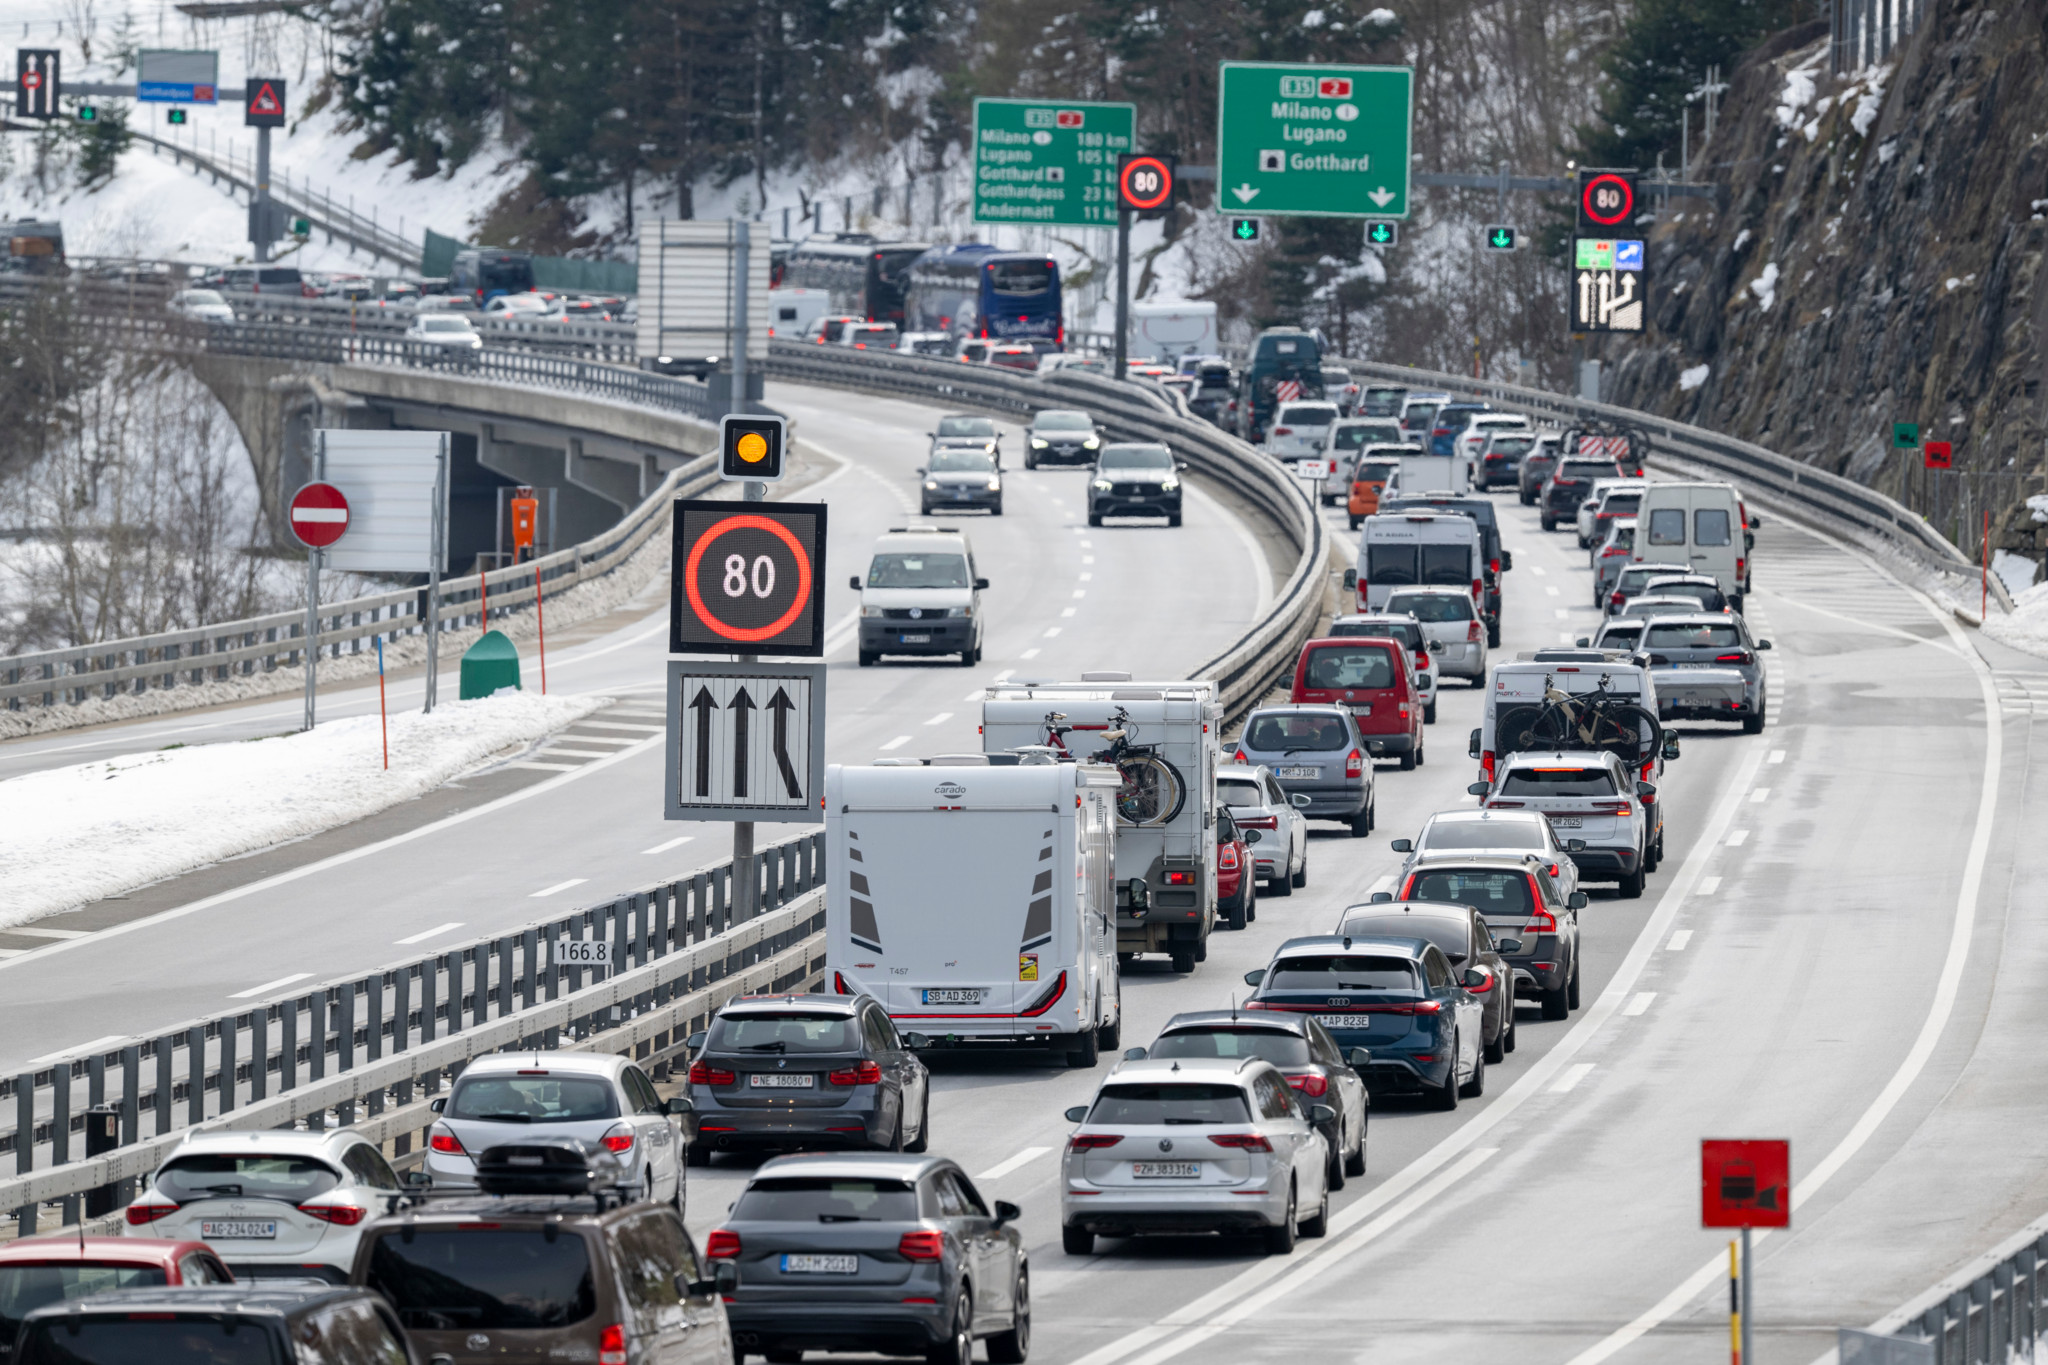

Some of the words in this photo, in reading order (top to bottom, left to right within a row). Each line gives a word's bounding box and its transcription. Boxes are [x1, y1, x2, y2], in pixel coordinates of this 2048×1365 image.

[1271, 101, 1332, 121] Milano
[980, 129, 1031, 145] Milano
[1077, 132, 1104, 147] 180
[1106, 132, 1128, 148] km
[1283, 123, 1347, 146] Lugano
[980, 149, 1033, 165] Lugano
[1077, 150, 1103, 164] 105
[1105, 150, 1119, 165] k
[1290, 153, 1370, 172] Gotthard
[979, 166, 1044, 181] Gotthard
[1093, 169, 1102, 184] 3
[1105, 169, 1119, 184] k
[1135, 171, 1158, 193] 80
[978, 183, 1065, 202] Gotthardpass
[1084, 186, 1102, 201] 23
[1104, 186, 1119, 201] k
[1597, 188, 1620, 209] 80
[978, 203, 1055, 219] Andermatt
[1084, 206, 1100, 220] 11
[723, 553, 776, 599] 80
[934, 785, 967, 794] carado
[1563, 818, 1581, 826] 2025
[559, 942, 607, 961] 166.8
[889, 967, 909, 975] T457
[928, 991, 941, 1001] SB
[946, 991, 959, 1001] AD
[960, 991, 979, 1001] 369
[1328, 1016, 1342, 1026] AP
[1343, 1016, 1368, 1026] 823E
